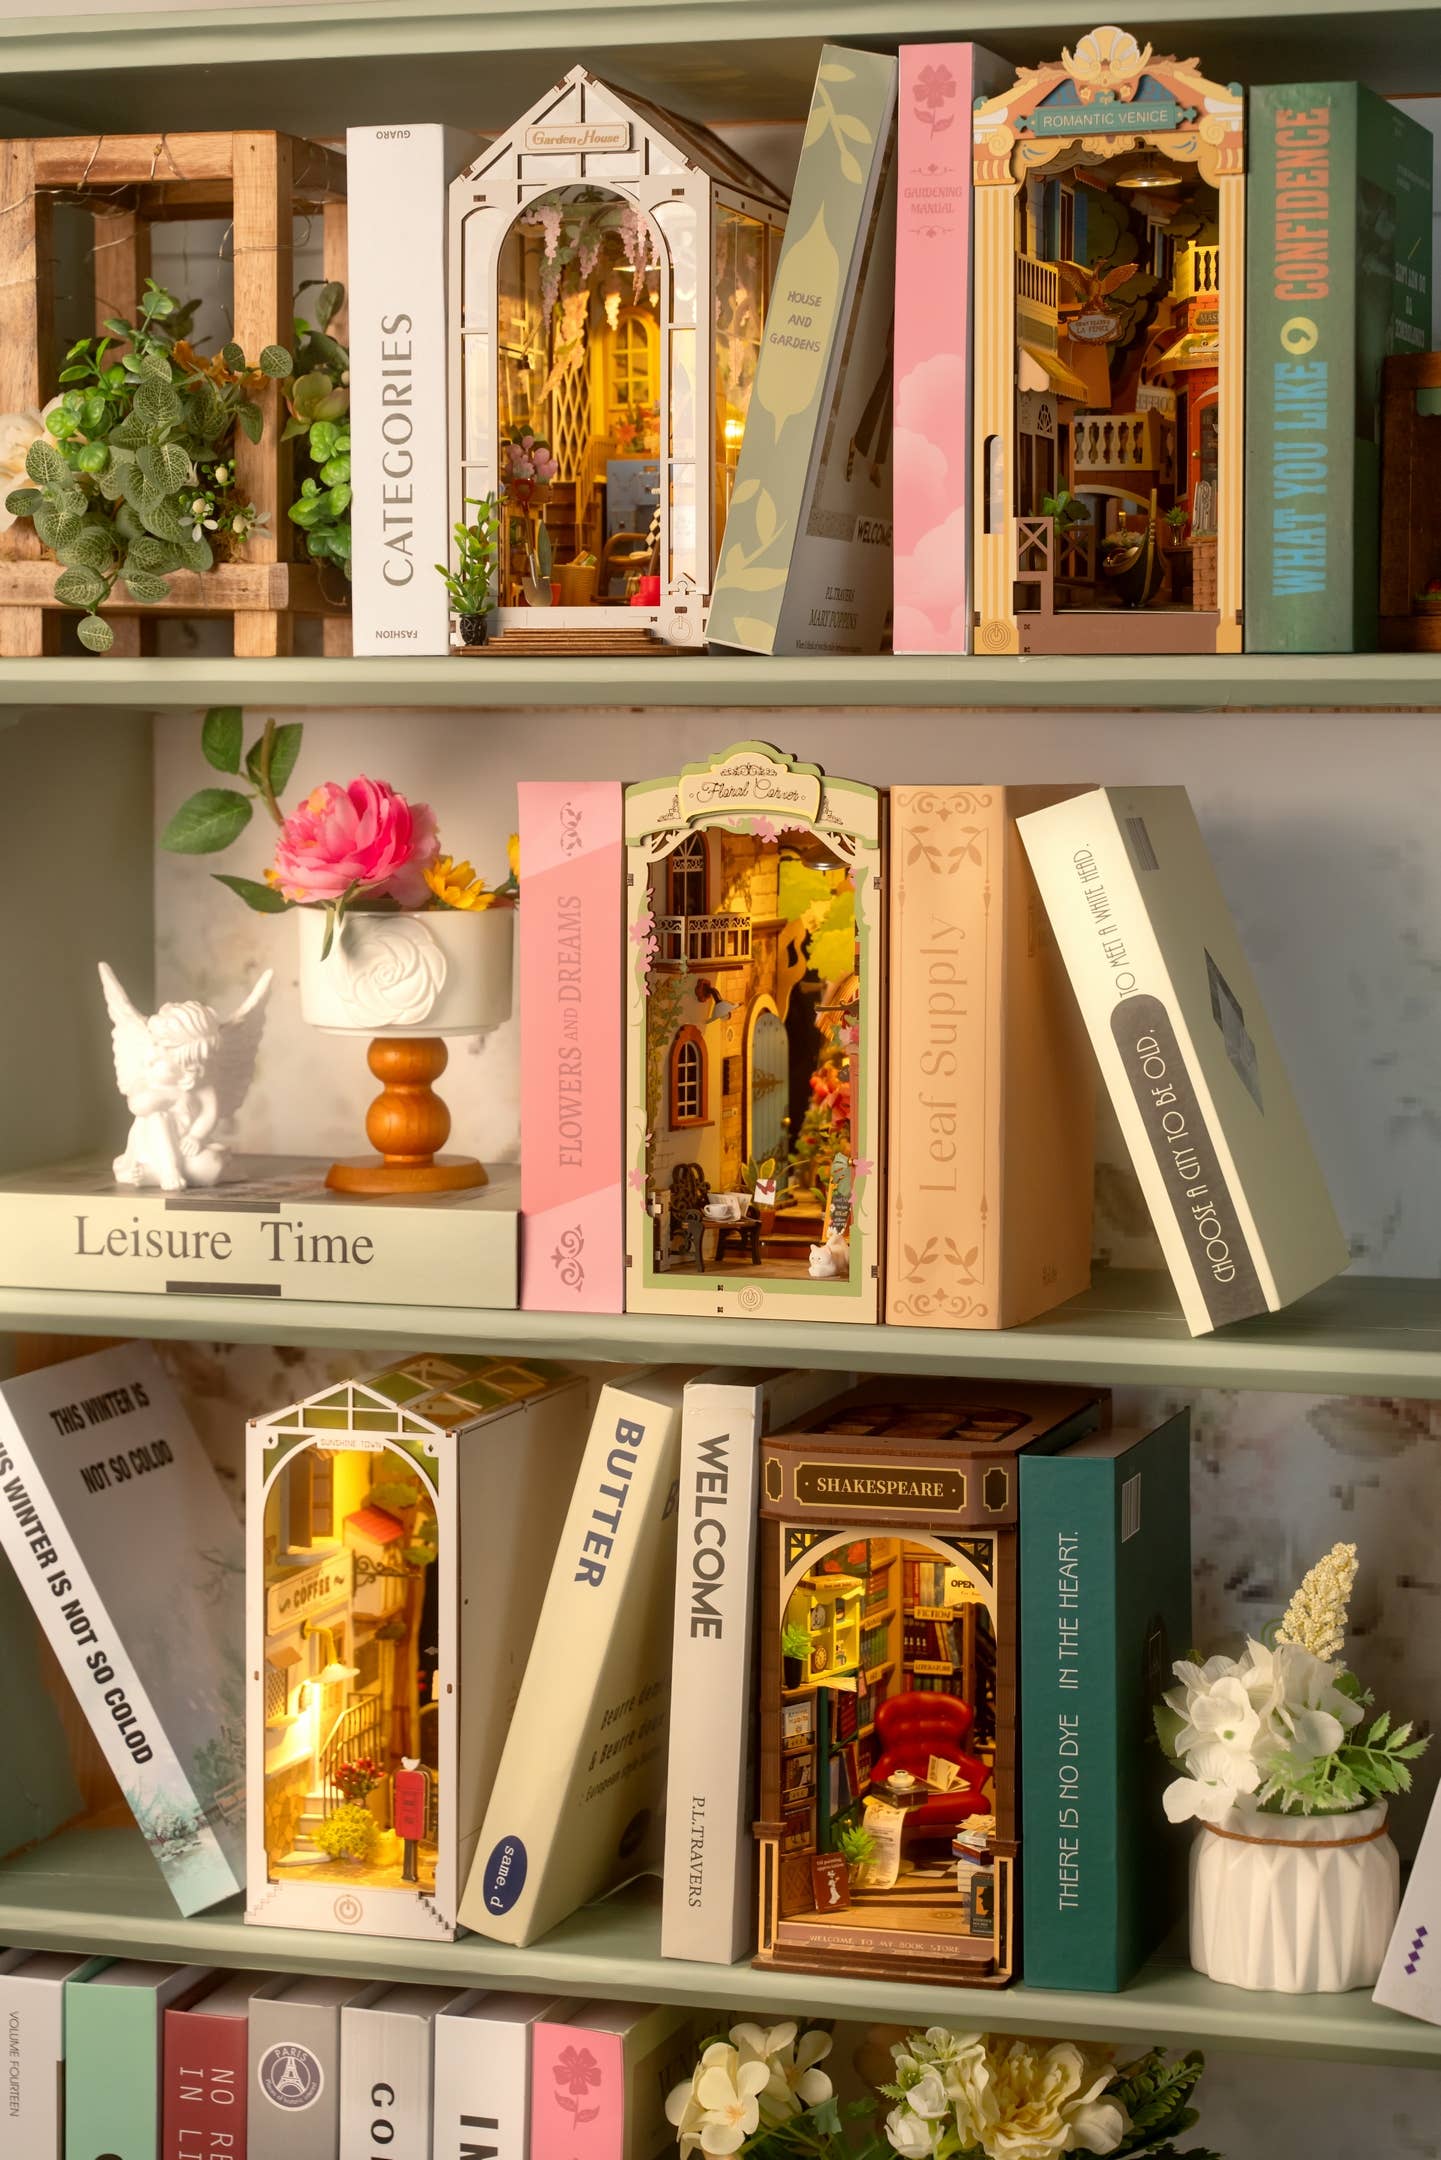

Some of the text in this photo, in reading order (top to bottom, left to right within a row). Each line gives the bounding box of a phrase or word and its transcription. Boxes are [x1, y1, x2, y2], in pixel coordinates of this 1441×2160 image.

[1043, 109, 1168, 128] ROMANTIC VENICE
[532, 129, 620, 146] Garden House
[1274, 106, 1331, 300] CONFIDENCE
[787, 290, 822, 307] HOUSE
[788, 313, 812, 328] AND
[769, 332, 821, 352] GARDENS
[1274, 361, 1328, 430] LIKE
[381, 313, 414, 587] CATEGORIES
[1273, 442, 1328, 499] YOU
[1272, 508, 1327, 596] WHAT
[808, 608, 832, 627] MARY
[375, 630, 418, 639] FASHION
[697, 778, 800, 803] Floral Corner
[1084, 884, 1112, 923] WHITE
[1098, 924, 1118, 936] A
[1102, 938, 1129, 968] MEET
[1115, 971, 1138, 998] TO
[558, 894, 583, 1168] FLOWERS AND DREAMS
[919, 913, 967, 1192] Leaf Supply
[1151, 1083, 1177, 1106] BE
[1162, 1110, 1189, 1143] TO
[1172, 1147, 1201, 1181] CITY
[1186, 1184, 1209, 1199] A
[74, 1215, 375, 1265] Leisure Time
[1192, 1200, 1236, 1283] CHOOSE
[48, 1381, 150, 1436] THIS WINTER IS
[320, 1438, 382, 1449] SUNSHINE TOWN
[79, 1439, 174, 1494] NOT SO COLOD
[574, 1417, 646, 1588] BUTTER
[817, 1477, 944, 1497] SHAKESPEARE
[690, 1433, 730, 1640] WELCOME
[294, 1576, 330, 1609] COFFEE
[951, 1580, 975, 1589] OPEN
[2, 1476, 153, 1765] WINTER IS NOT SO COLOD
[917, 1608, 951, 1619] FICTION
[1058, 1530, 1079, 1911] THERE IS NO DYE IN THE HEART.
[688, 1795, 706, 1908] P.L.TRAVERS
[809, 1935, 854, 1945] WELCOME
[899, 1942, 924, 1950] BOOK
[930, 1945, 960, 1953] STORE
[9, 2010, 20, 2118] VOLUME FOURTEEN
[274, 2047, 308, 2061] PARIS
[179, 2066, 204, 2101] IN
[210, 2068, 235, 2105] NO
